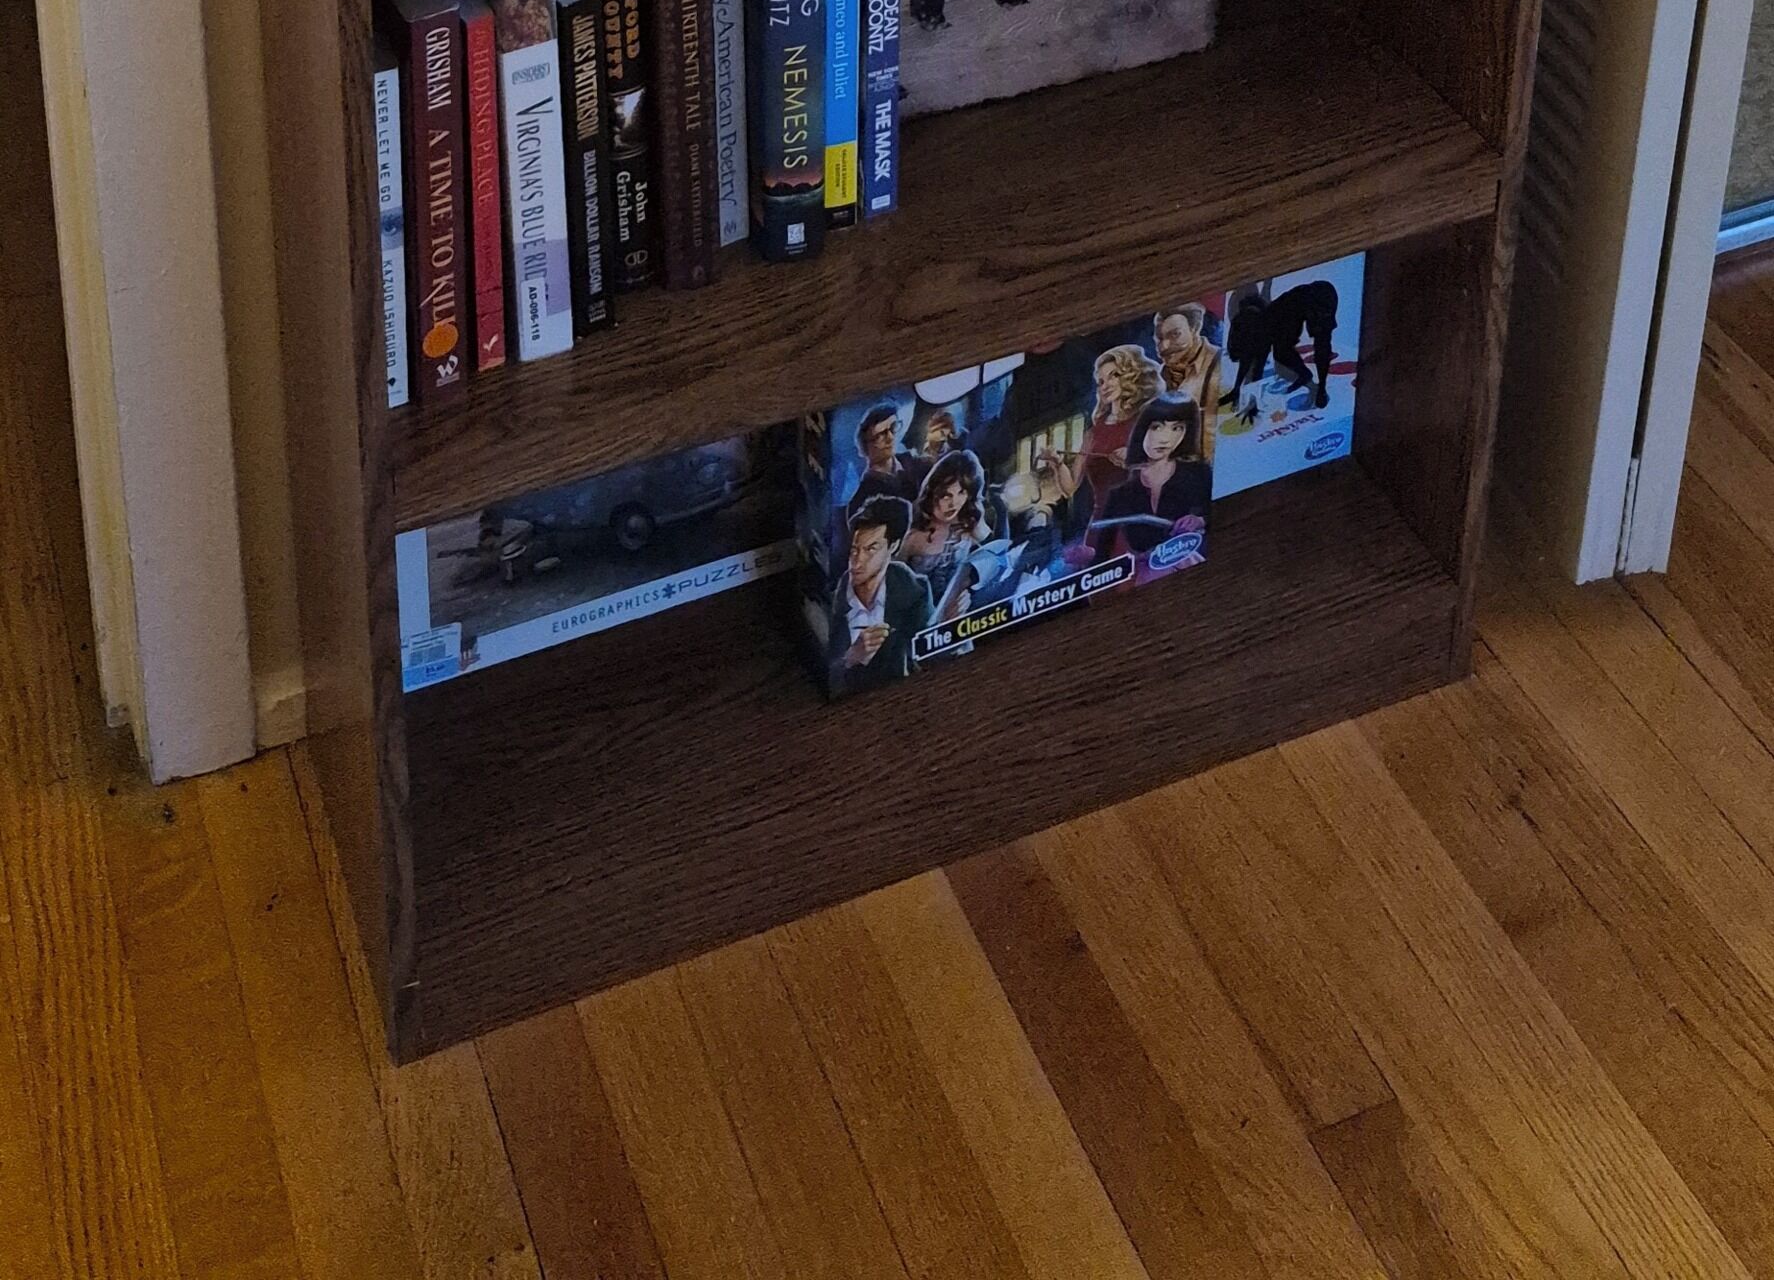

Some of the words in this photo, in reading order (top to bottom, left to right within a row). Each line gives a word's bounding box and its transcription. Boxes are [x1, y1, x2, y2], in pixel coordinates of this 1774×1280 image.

[572, 14, 596, 64] JAMES
[835, 31, 849, 59] and
[426, 26, 451, 111] GRISHAM
[472, 48, 490, 134] HIDING
[716, 8, 735, 129] American
[833, 61, 851, 100] Juliet
[377, 79, 388, 124] NEVER
[574, 61, 600, 141] PATTERSON
[684, 91, 702, 132] TALE
[783, 45, 808, 169] NEMESIS
[875, 99, 892, 130] THE
[379, 130, 389, 155] LET
[428, 129, 451, 148] A
[515, 96, 554, 203] VIRGINIA'S
[874, 131, 892, 182] MASK
[380, 162, 391, 179] ME
[429, 150, 453, 225] TIME
[475, 142, 496, 206] PLACE
[583, 149, 599, 197] BILLION
[719, 131, 737, 207] Poetry
[380, 184, 391, 203] GO
[616, 170, 633, 242] Grisham
[634, 181, 648, 223] John
[521, 207, 546, 250] BLUE
[585, 198, 600, 243] DOLLAR
[431, 232, 455, 269] TO
[587, 243, 603, 294] RANSOM
[383, 260, 394, 301] KAZUO
[385, 307, 397, 368] ISHIGURO
[552, 590, 660, 634] EUROGRAPHICS
[923, 629, 952, 652] The
[956, 606, 1008, 638] Classic
[1012, 580, 1076, 618] Mystery
[1080, 563, 1123, 591] Game
